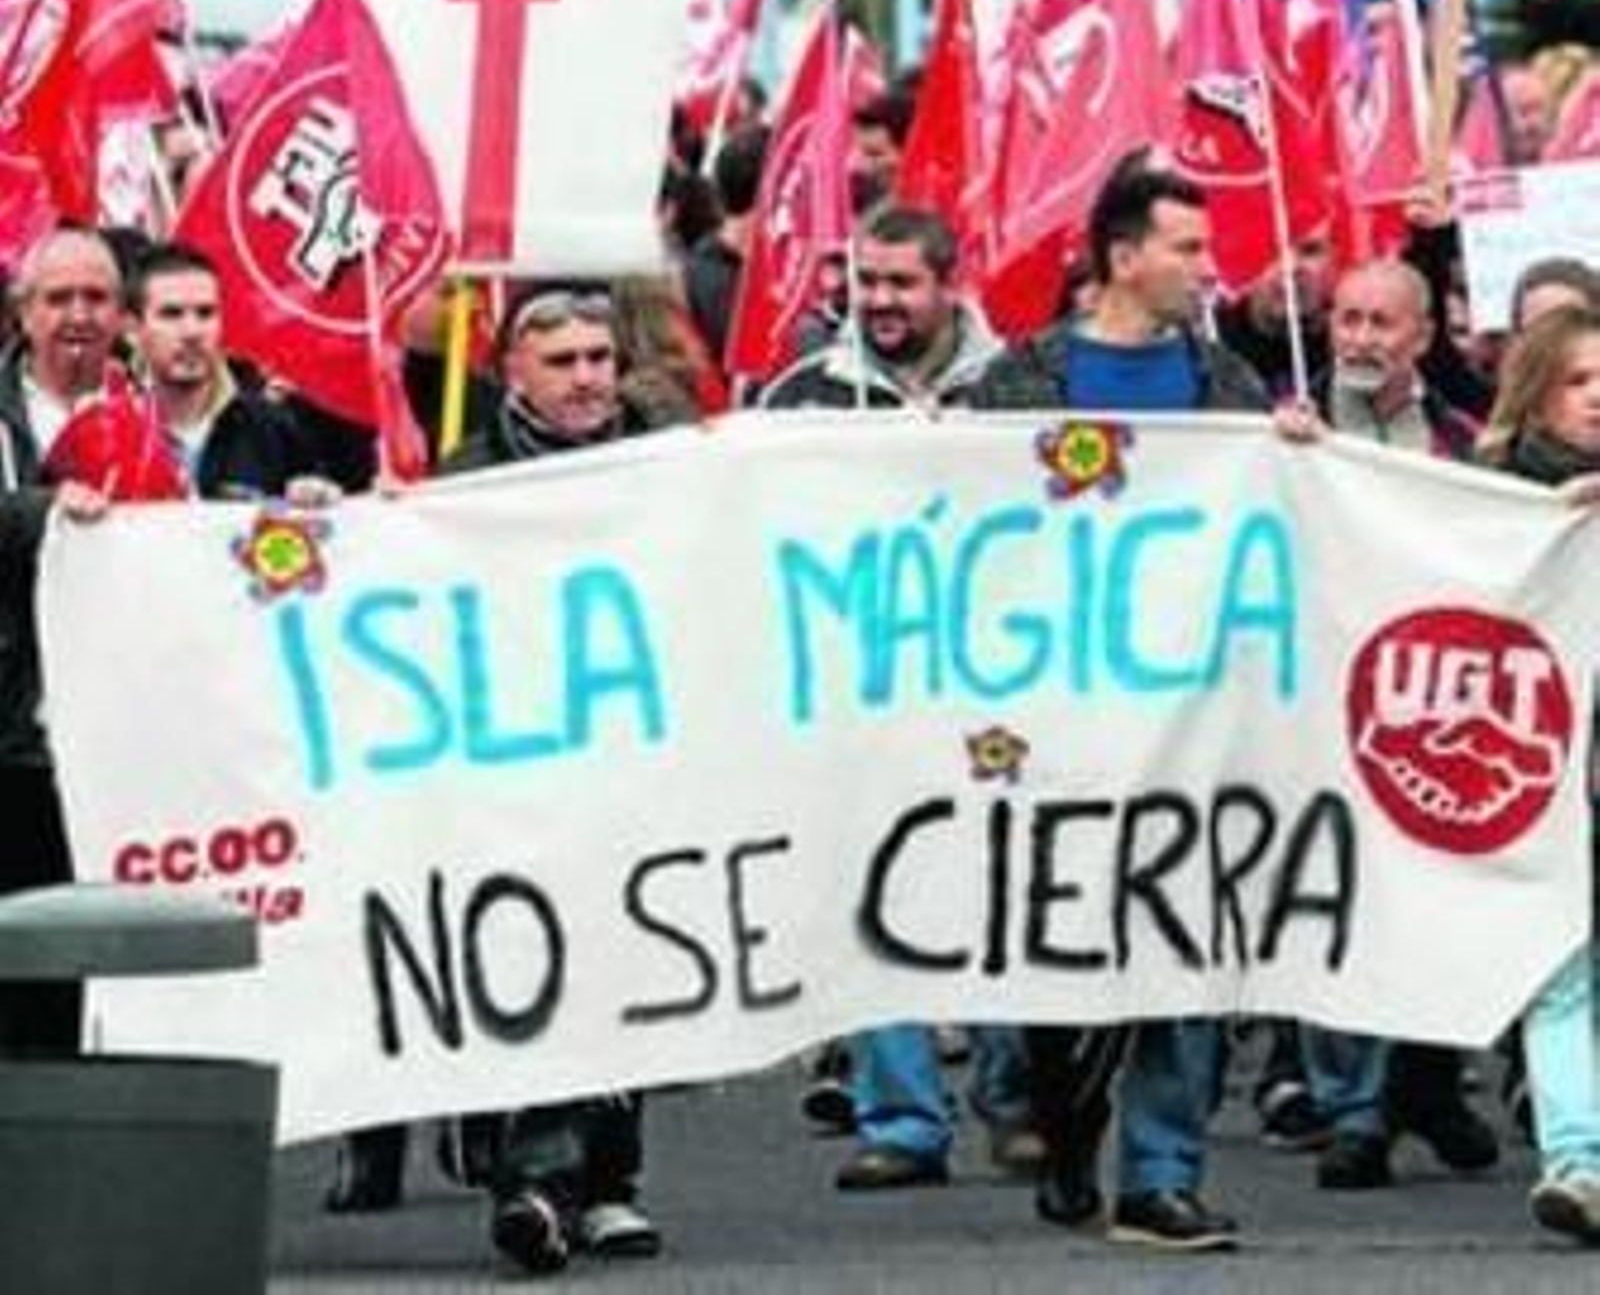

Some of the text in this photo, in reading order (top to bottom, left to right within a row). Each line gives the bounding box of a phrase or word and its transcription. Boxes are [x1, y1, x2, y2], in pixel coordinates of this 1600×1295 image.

[278, 494, 1300, 790] ISLA MÁGICA
[1373, 640, 1564, 742] UGT
[362, 786, 1360, 1056] NO SE CIERRA
